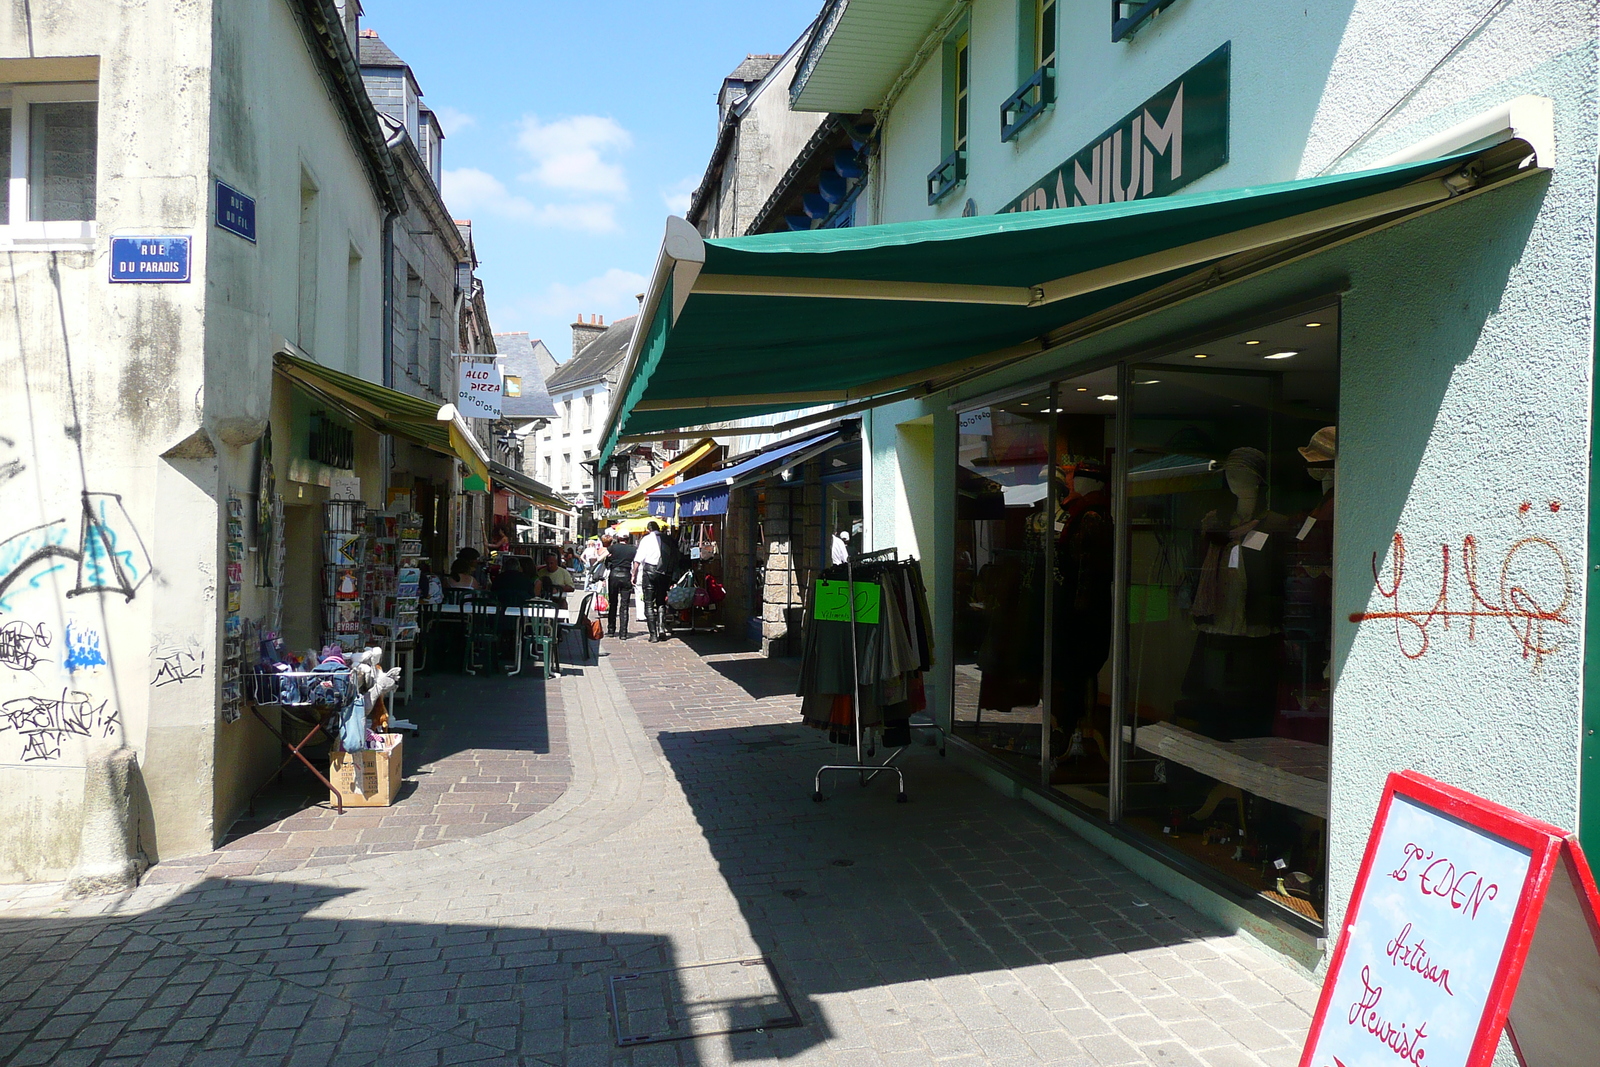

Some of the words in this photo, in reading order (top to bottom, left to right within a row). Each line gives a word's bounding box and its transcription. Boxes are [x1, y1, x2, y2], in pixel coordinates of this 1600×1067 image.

[1009, 81, 1184, 213] ANIUM
[230, 196, 244, 211] RUE
[226, 210, 236, 223] DU
[237, 215, 249, 230] FIL
[141, 244, 165, 256] RUE
[119, 261, 135, 273] DU
[140, 261, 180, 273] PARADIS
[466, 370, 488, 380] ALLO
[471, 382, 500, 392] PIZZA
[1386, 842, 1498, 921] L'EDEN
[1386, 922, 1454, 997] Artisan
[1348, 964, 1429, 1067] Fleuriste
